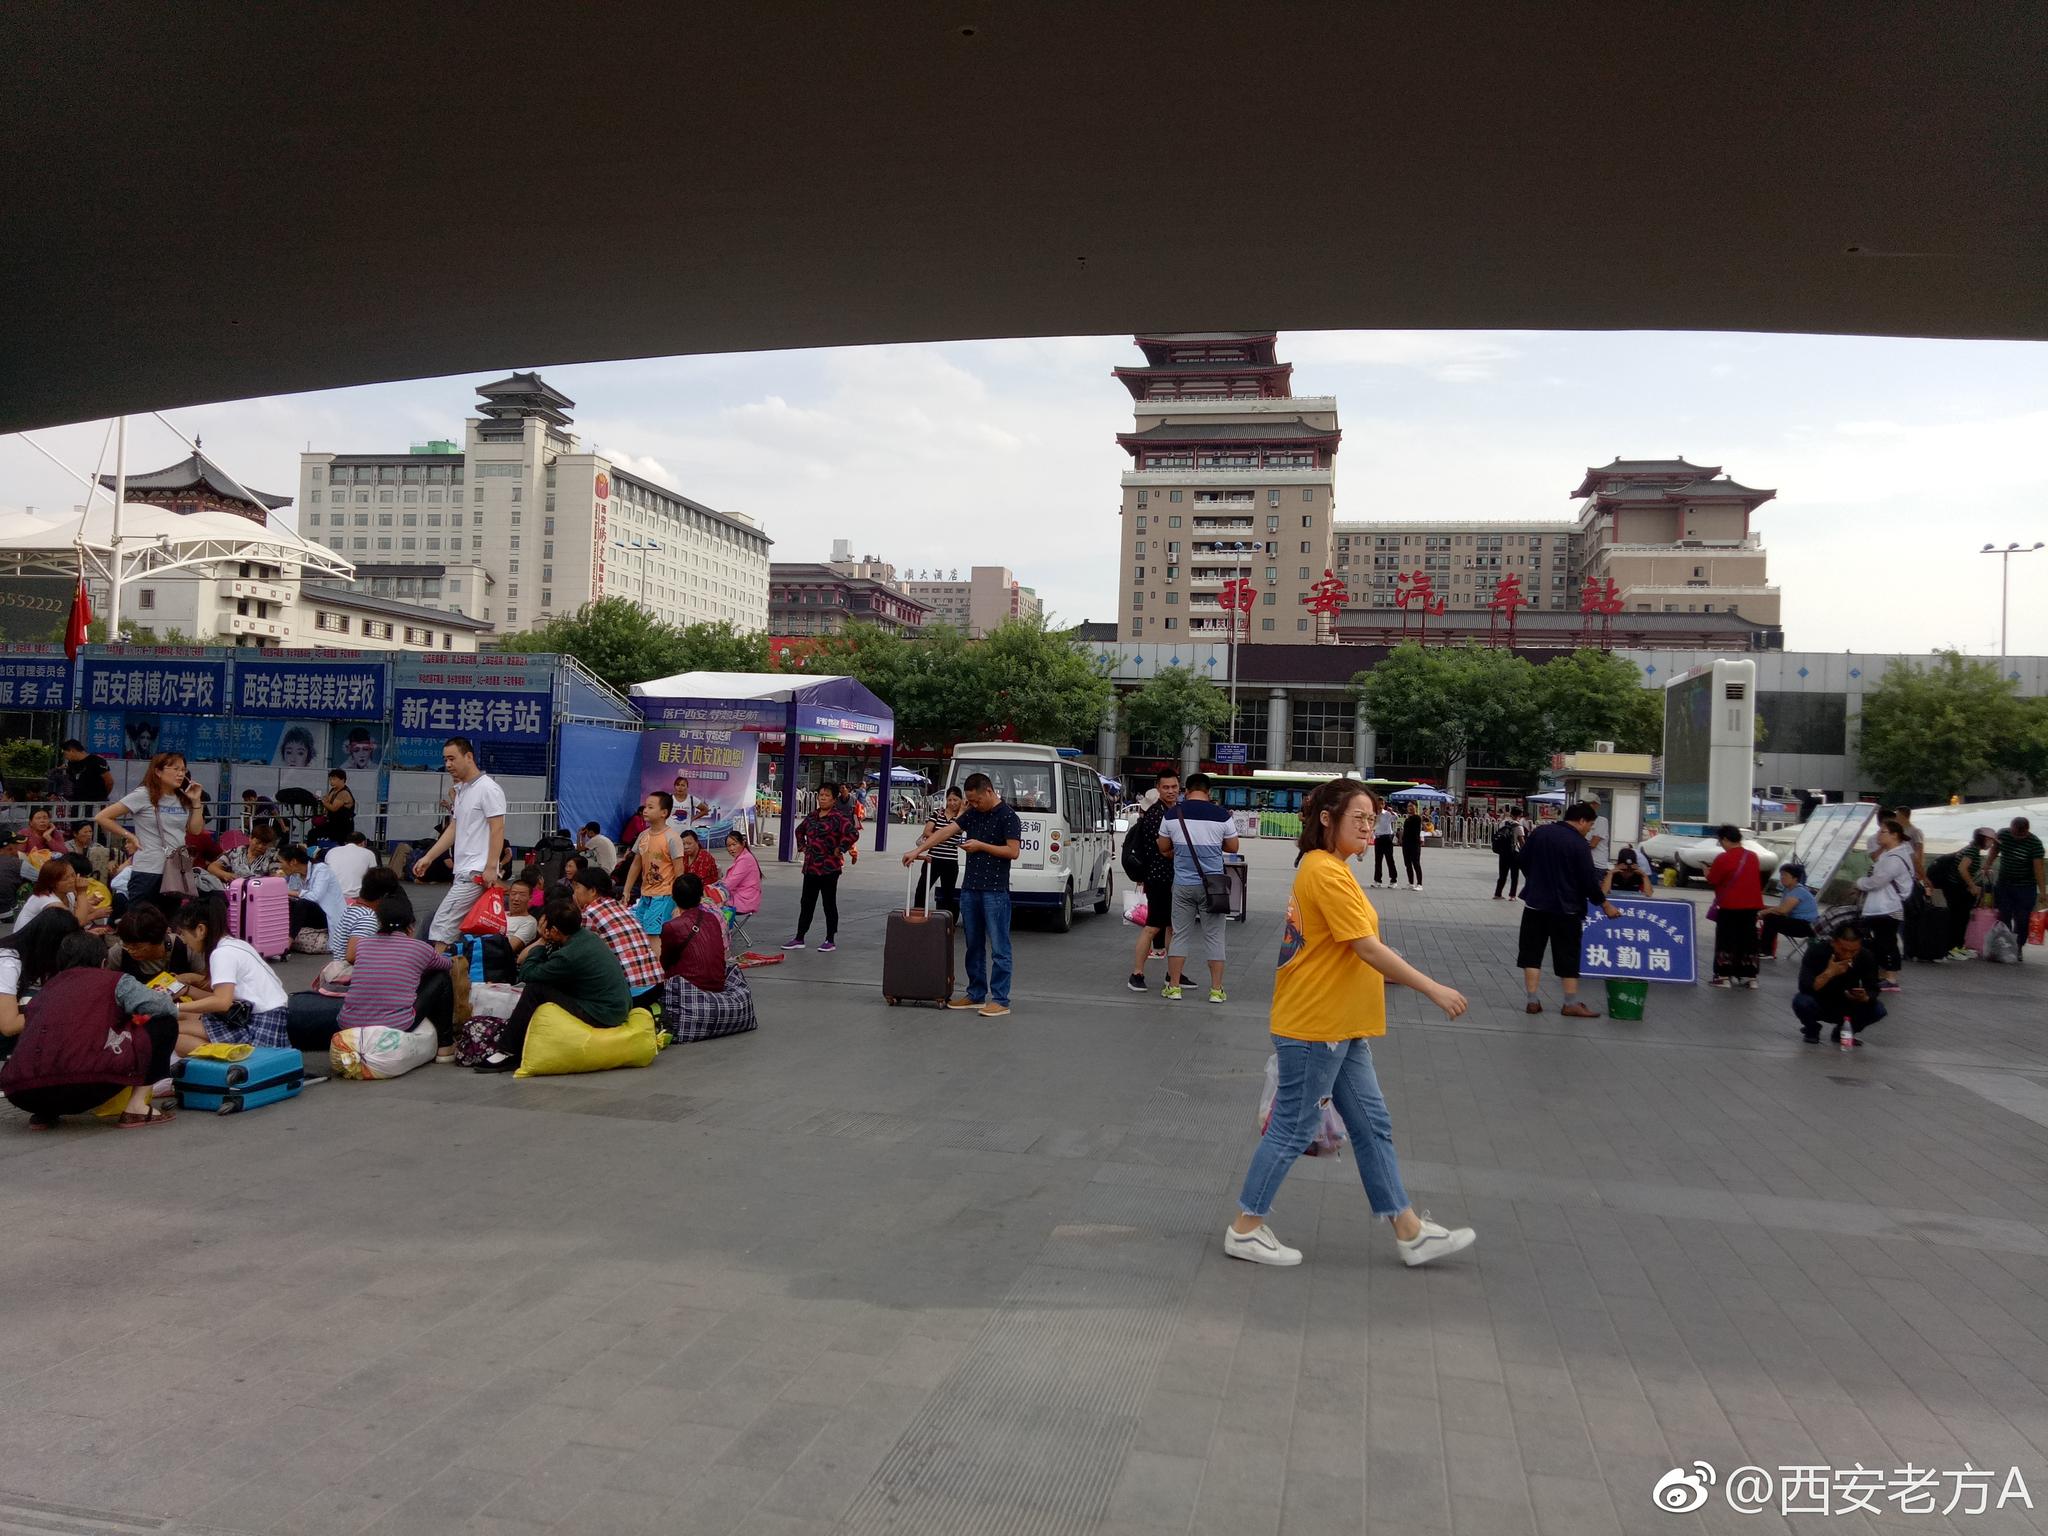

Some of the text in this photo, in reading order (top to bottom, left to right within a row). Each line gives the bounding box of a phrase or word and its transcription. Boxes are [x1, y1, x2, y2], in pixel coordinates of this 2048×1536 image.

[1217, 569, 1625, 620] 西安汽车站
[92, 670, 215, 708] 西安康博尔学校
[243, 673, 376, 711] 西安金栗美容美发学校
[401, 697, 542, 734] 新生接待站
[663, 708, 708, 720] 落户西安
[1605, 928, 1650, 943] 11号岗
[1586, 944, 1671, 972] 执勤岗
